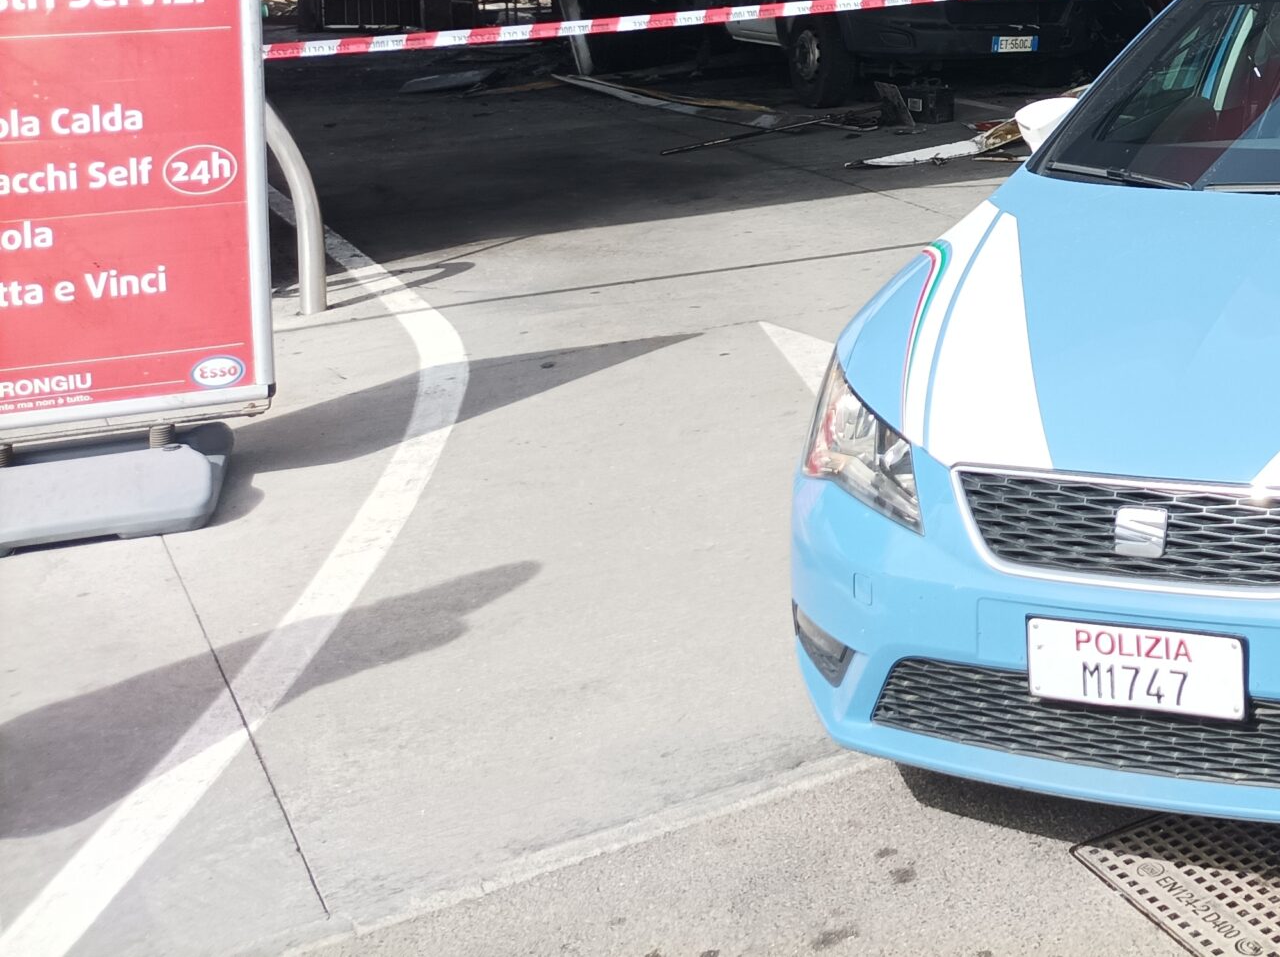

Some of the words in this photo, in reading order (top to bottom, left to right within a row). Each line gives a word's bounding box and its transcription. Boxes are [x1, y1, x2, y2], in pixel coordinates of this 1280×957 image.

[51, 103, 143, 136] Calda
[88, 156, 153, 189] Self
[171, 151, 231, 186] 24h
[54, 279, 75, 302] e
[84, 265, 168, 300] Vinci
[0, 373, 92, 398] RONGIU
[17, 401, 34, 409] ma
[36, 399, 55, 407] non
[66, 394, 94, 403] tutto.
[1074, 629, 1193, 663] POLIZIA
[1081, 662, 1190, 706] M1747
[1201, 912, 1241, 940] D400
